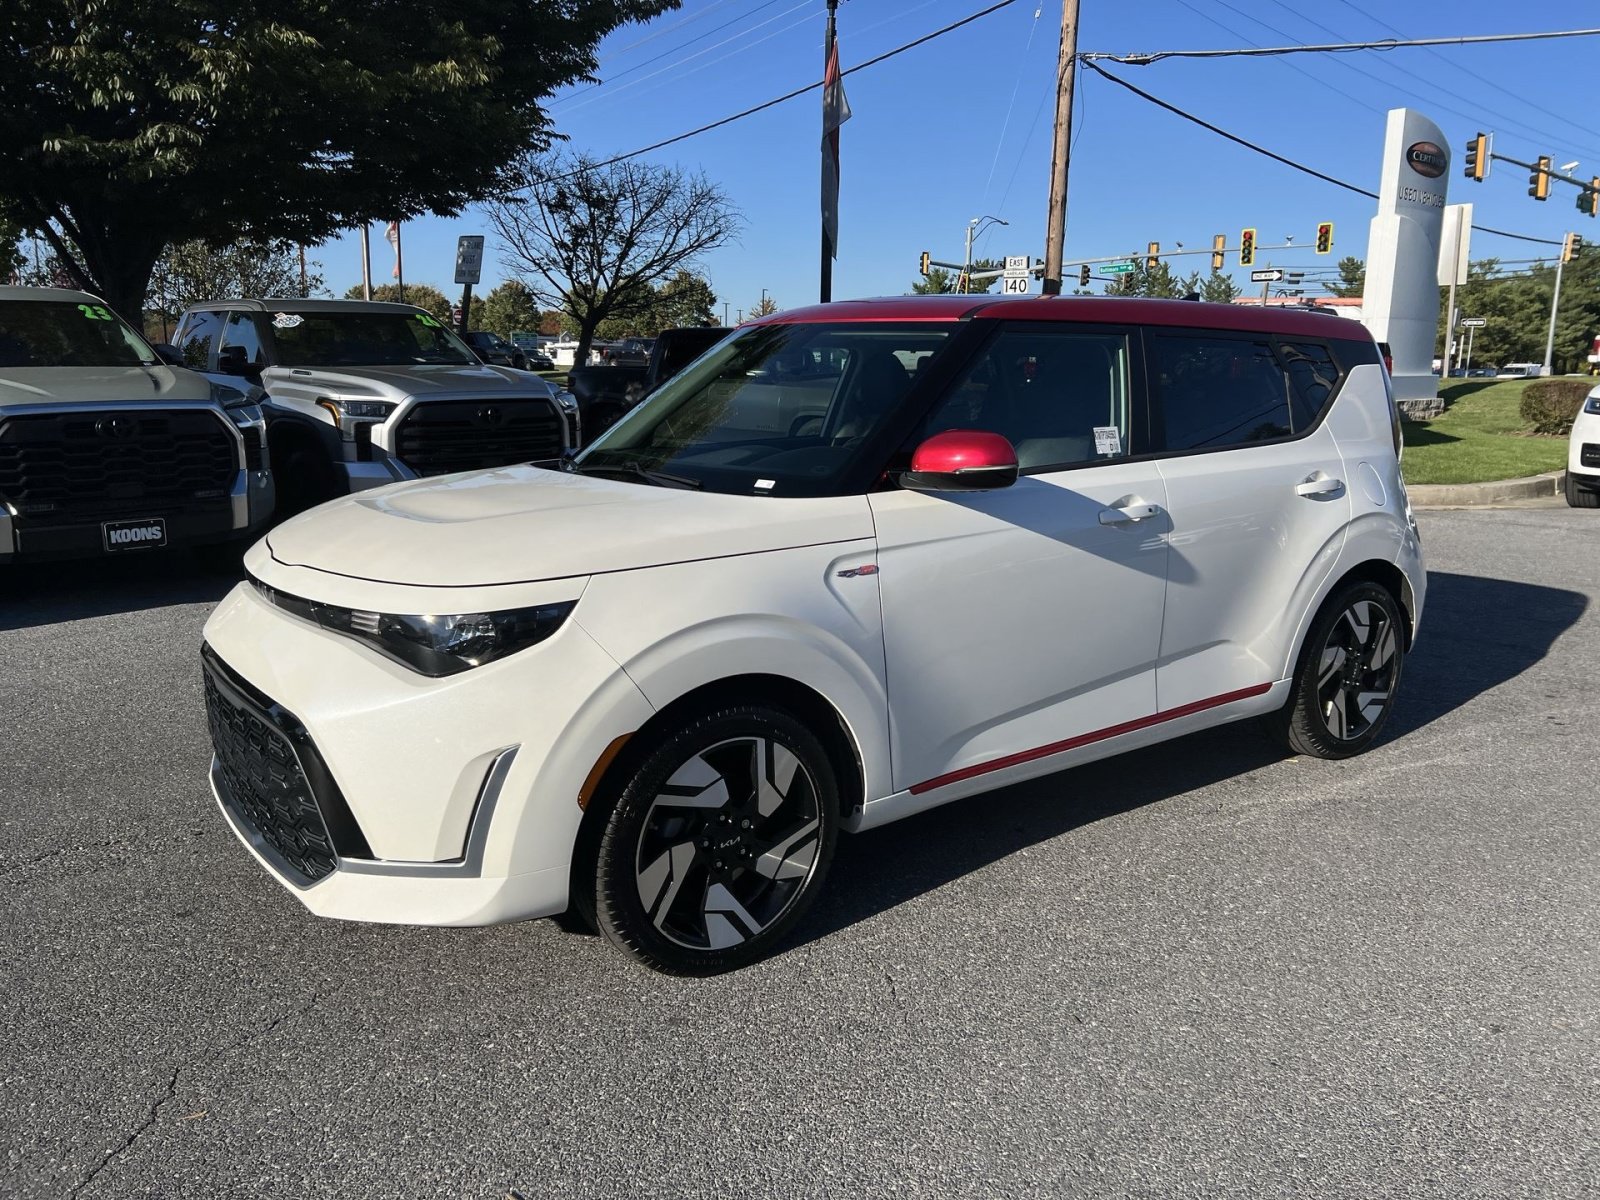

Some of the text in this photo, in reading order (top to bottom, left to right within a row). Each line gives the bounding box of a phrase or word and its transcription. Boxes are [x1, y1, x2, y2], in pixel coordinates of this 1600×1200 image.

[1399, 186, 1418, 202] USED
[1009, 258, 1023, 267] EAST
[1004, 279, 1027, 293] 140
[77, 304, 113, 321] 23
[109, 526, 162, 544] KOONS
